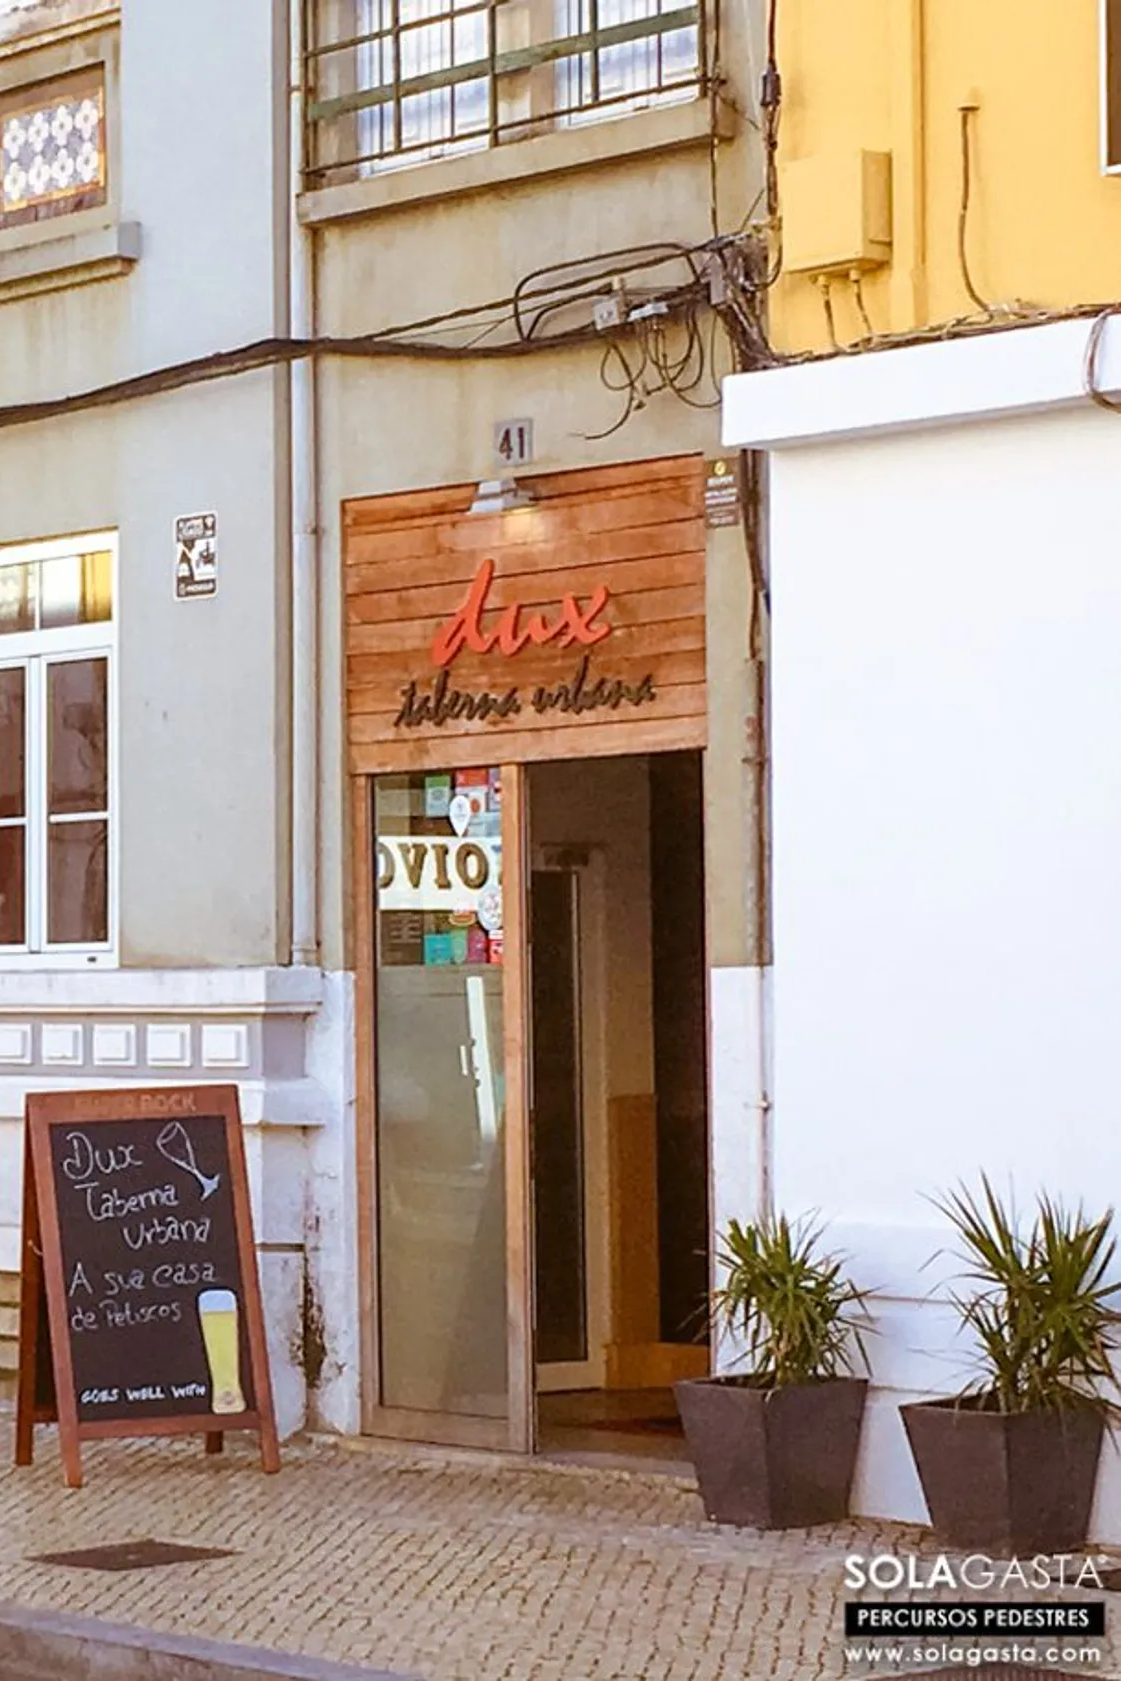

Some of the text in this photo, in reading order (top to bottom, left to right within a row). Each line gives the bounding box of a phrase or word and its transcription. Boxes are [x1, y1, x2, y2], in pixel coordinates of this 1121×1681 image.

[499, 427, 525, 460] 41
[432, 559, 612, 667] dux
[393, 654, 657, 727] taberna urbana
[63, 1131, 143, 1180] Dux
[74, 1182, 179, 1221] Taberna
[123, 1216, 210, 1250] Urbana
[68, 1261, 93, 1298] A
[103, 1269, 146, 1296] sua
[70, 1300, 183, 1331] de Petiscos
[80, 1382, 207, 1405] GOES WELL WITH
